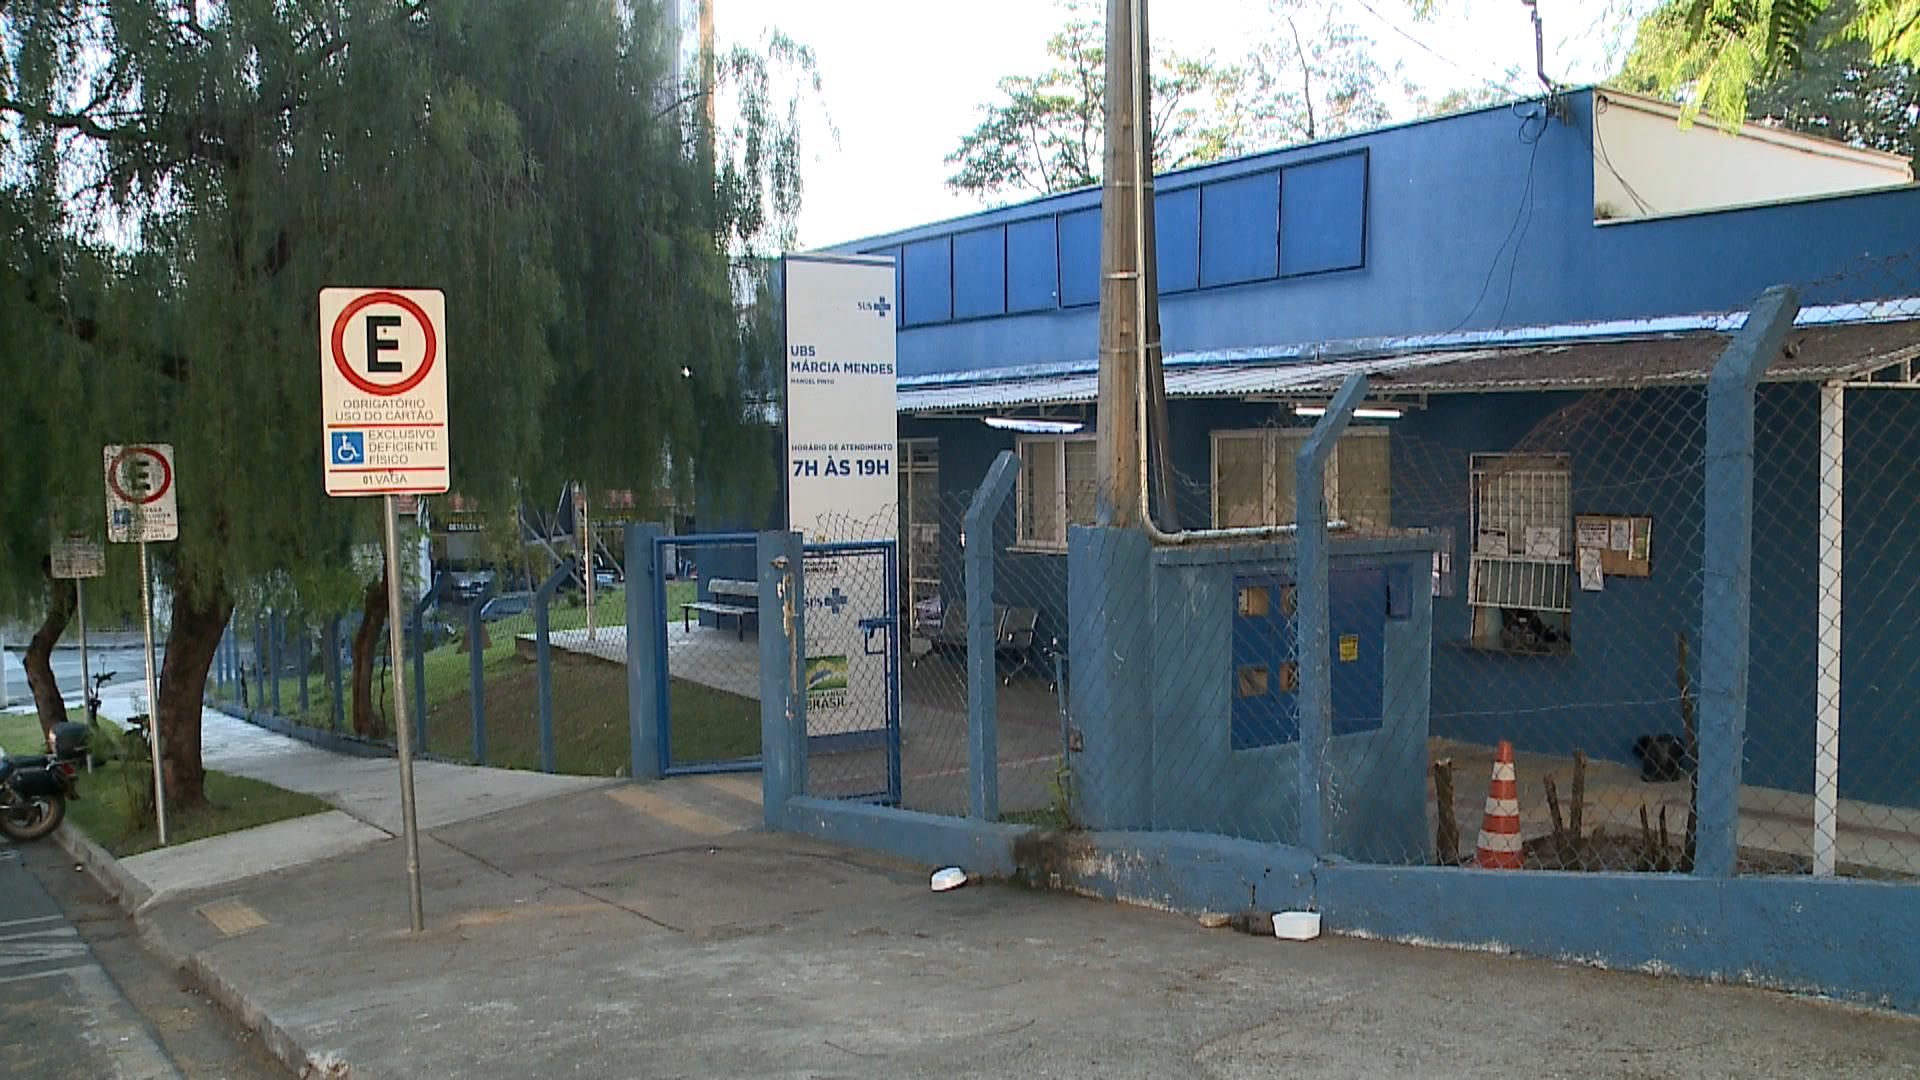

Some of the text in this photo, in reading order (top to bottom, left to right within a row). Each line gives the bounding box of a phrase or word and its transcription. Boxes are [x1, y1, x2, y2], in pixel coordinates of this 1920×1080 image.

[857, 301, 872, 311] SUS
[366, 315, 402, 373] E
[790, 345, 816, 357] UBS
[790, 358, 894, 375] MÁRCIA MENDES
[343, 397, 426, 409] OBRIGATÓRIO
[335, 409, 434, 421] USO DO CARTÃO
[368, 429, 436, 440] EXCLUSIVO
[369, 441, 438, 453] DEFICIENTE
[791, 442, 893, 452] HORÁRIO DE ATENDIMENTO
[369, 452, 409, 465] FÍSICO
[792, 455, 890, 477] 7H ÀS 19H
[363, 473, 408, 485] 01 VAGA
